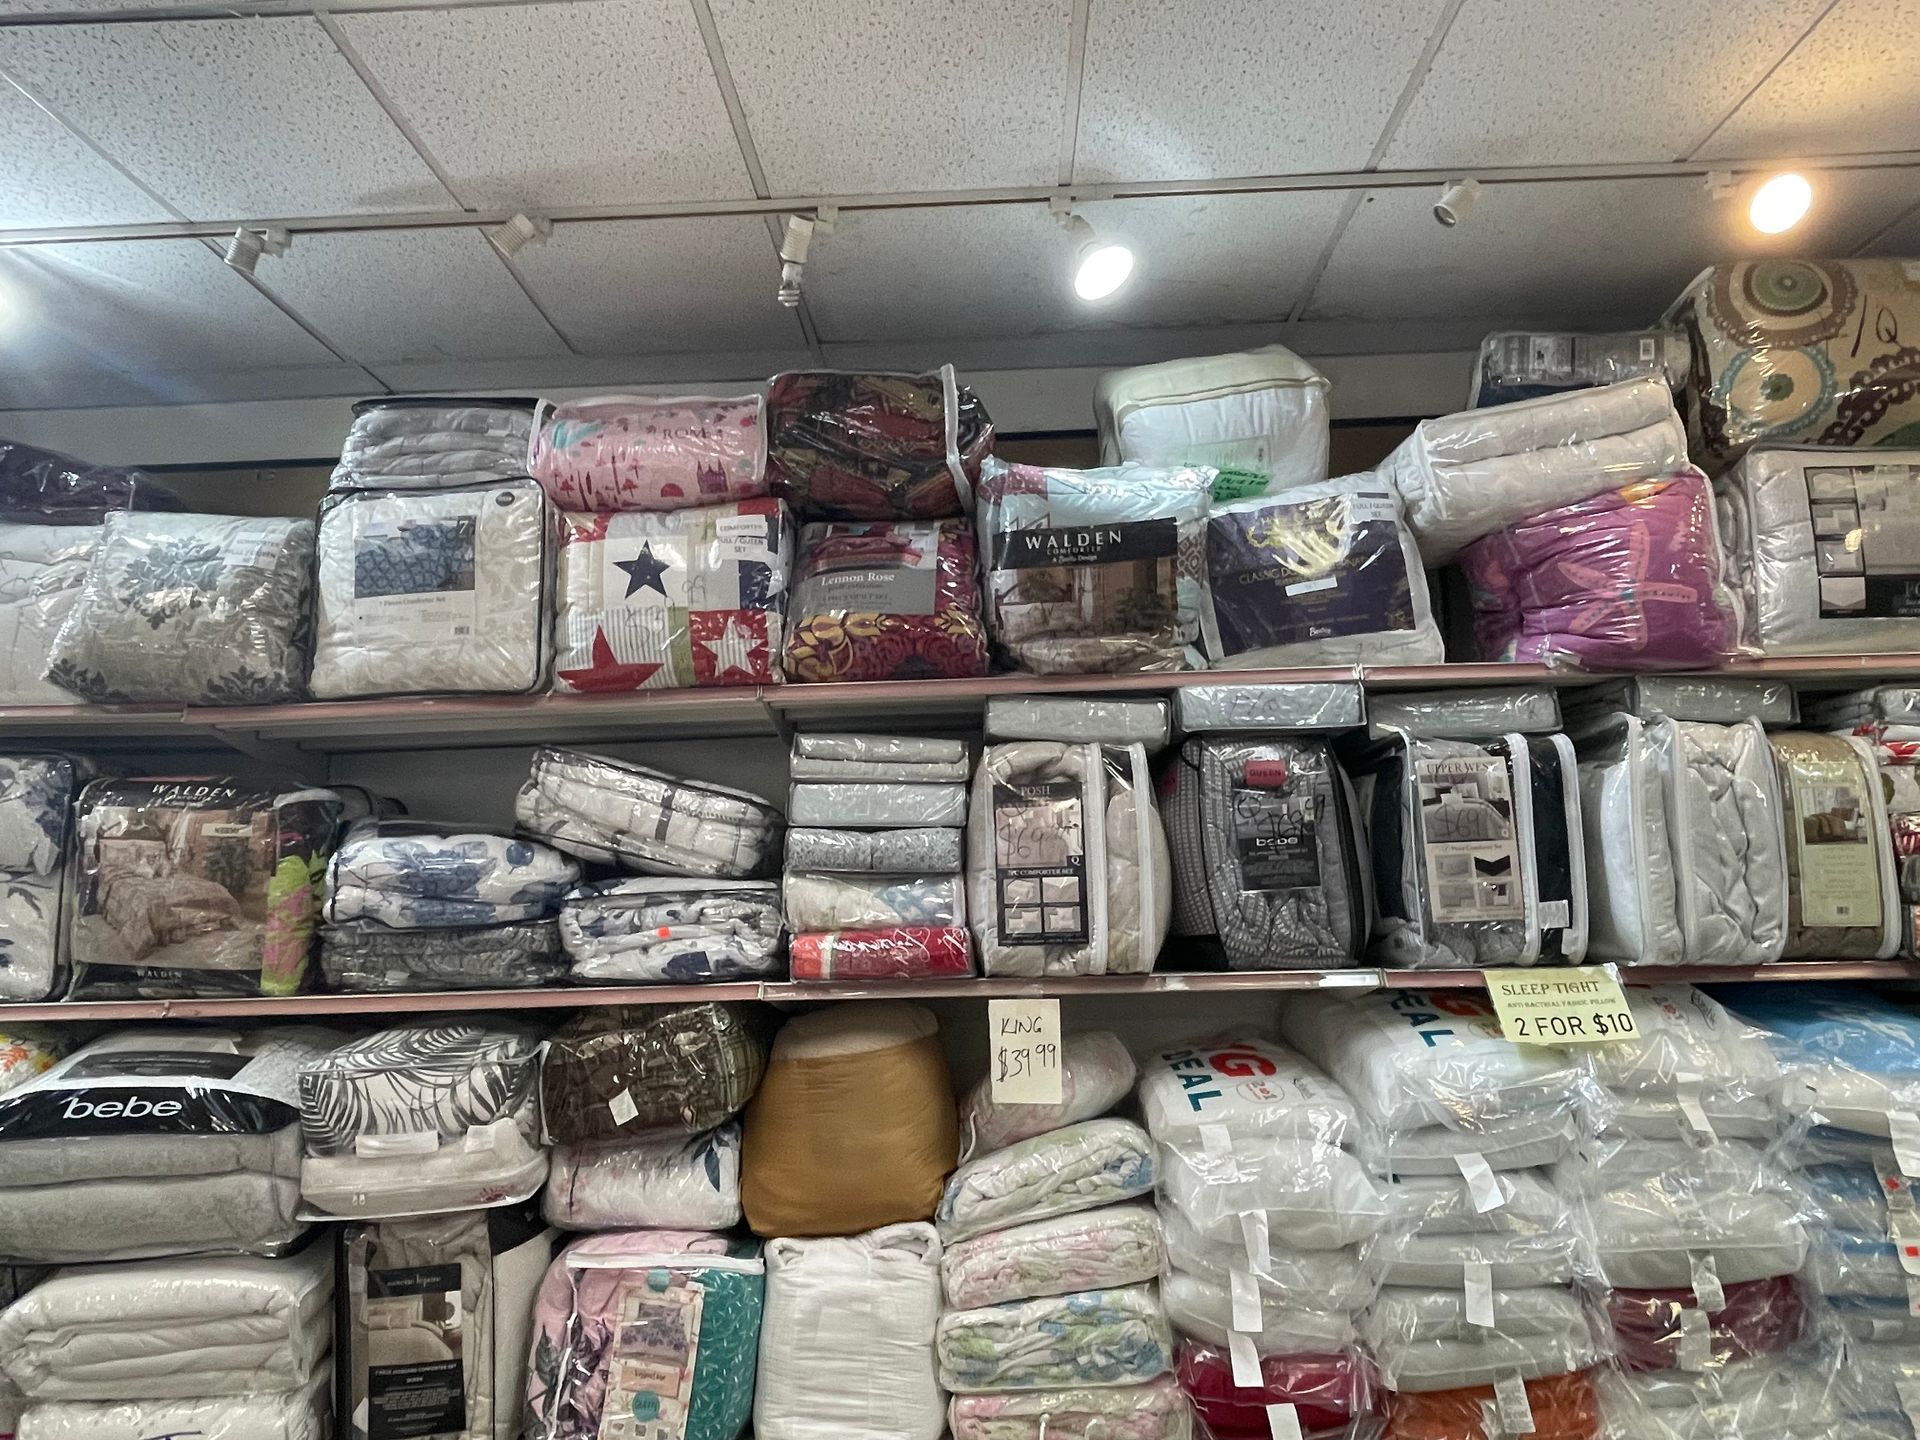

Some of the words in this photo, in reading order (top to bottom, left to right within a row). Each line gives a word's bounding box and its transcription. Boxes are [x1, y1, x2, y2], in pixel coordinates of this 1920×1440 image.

[459, 520, 469, 535] 7
[1025, 529, 1122, 550] WALDEN
[821, 574, 864, 587] Lennon
[868, 572, 895, 582] Rose
[1249, 769, 1282, 777] QUEEN
[152, 784, 237, 798] WALDEN
[1020, 785, 1051, 797] POSH
[1070, 855, 1081, 867] Q
[1501, 983, 1550, 996] SLEEP
[1553, 981, 1599, 994] TIGHT
[1001, 1015, 1043, 1036] KING
[1514, 1017, 1530, 1037] 2
[1535, 1016, 1588, 1037] FOR
[1592, 1012, 1634, 1037] $10
[1161, 1050, 1223, 1113] DEAL
[62, 1096, 183, 1119] bebe
